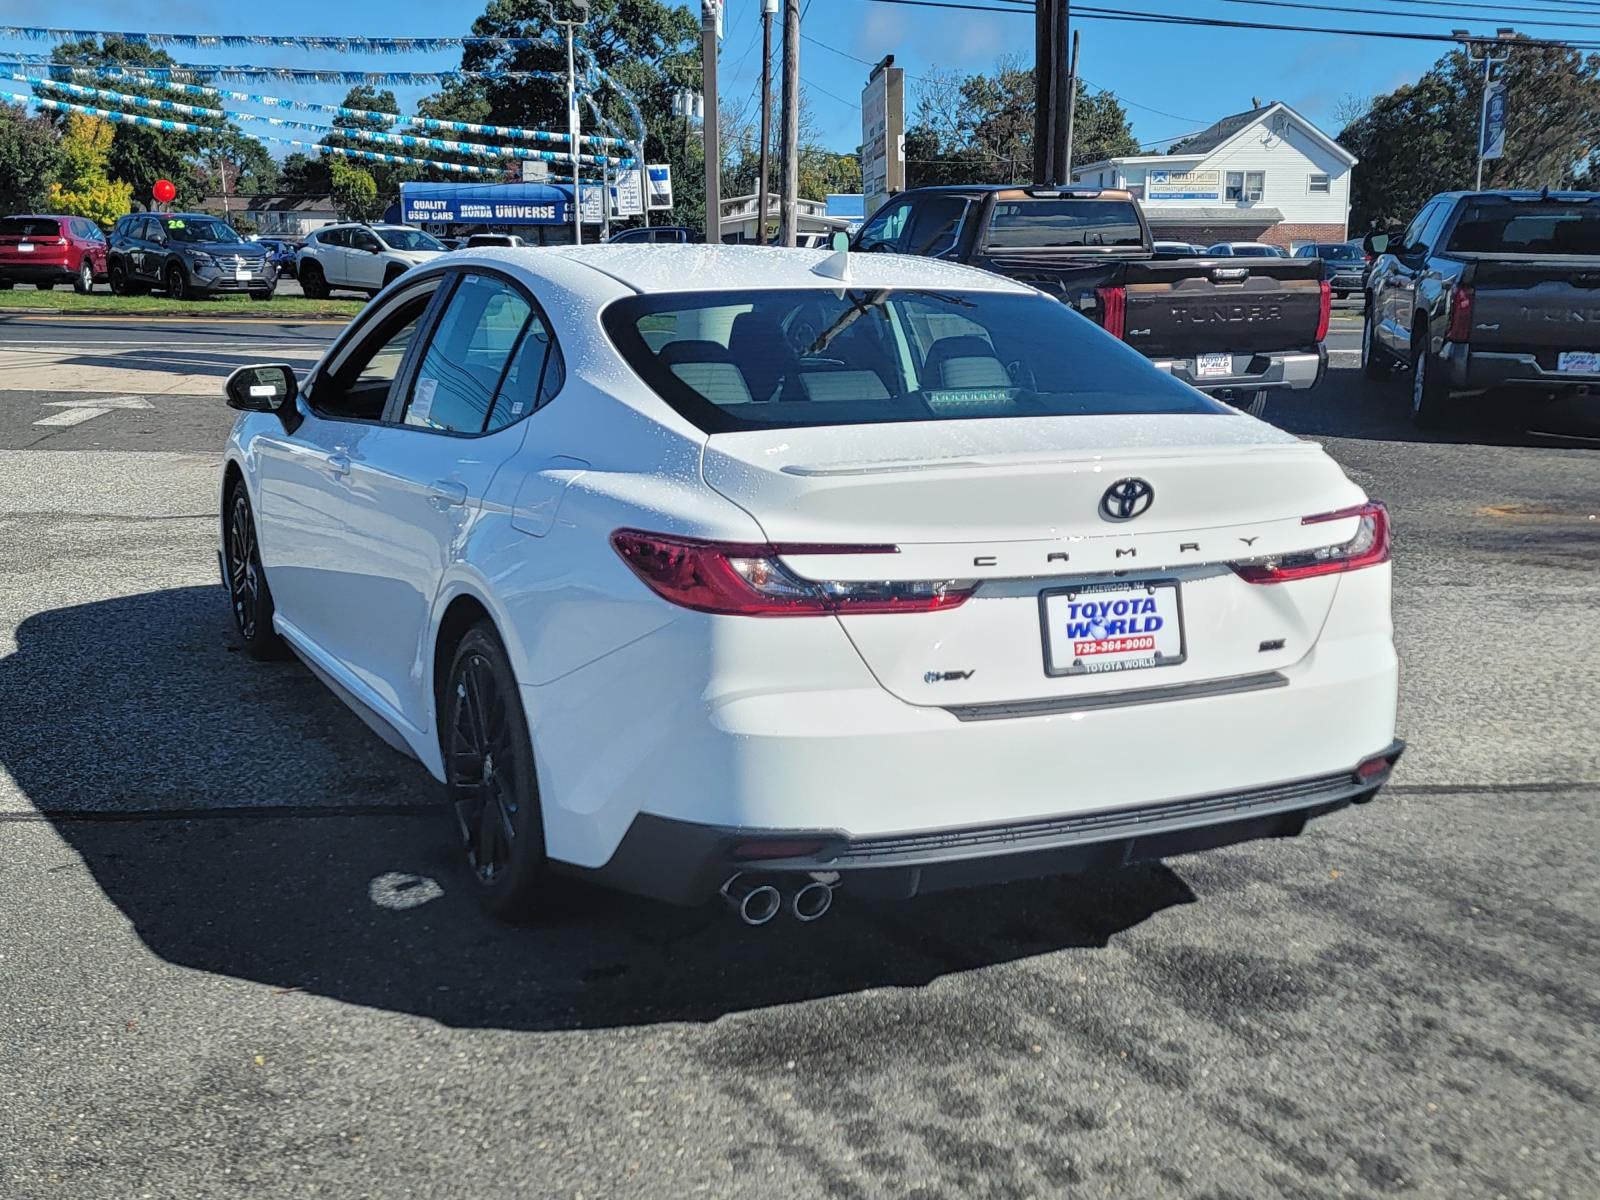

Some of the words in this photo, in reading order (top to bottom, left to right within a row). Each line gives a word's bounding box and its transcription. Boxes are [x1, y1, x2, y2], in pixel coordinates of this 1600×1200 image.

[413, 200, 447, 210] QUALITY
[460, 205, 493, 218] HONDA
[495, 205, 556, 219] UNIVERSE
[408, 211, 429, 220] USED
[431, 211, 454, 220] CARS
[1172, 305, 1282, 323] TUNDRA
[973, 536, 1260, 567] CAMRY
[1081, 583, 1132, 594] LAKEWOOD,
[1067, 597, 1157, 620] TOYOTA
[1075, 637, 1153, 655] 732-364-9000
[1085, 661, 1123, 673] TOYOTA
[1124, 659, 1156, 670] WORLD
